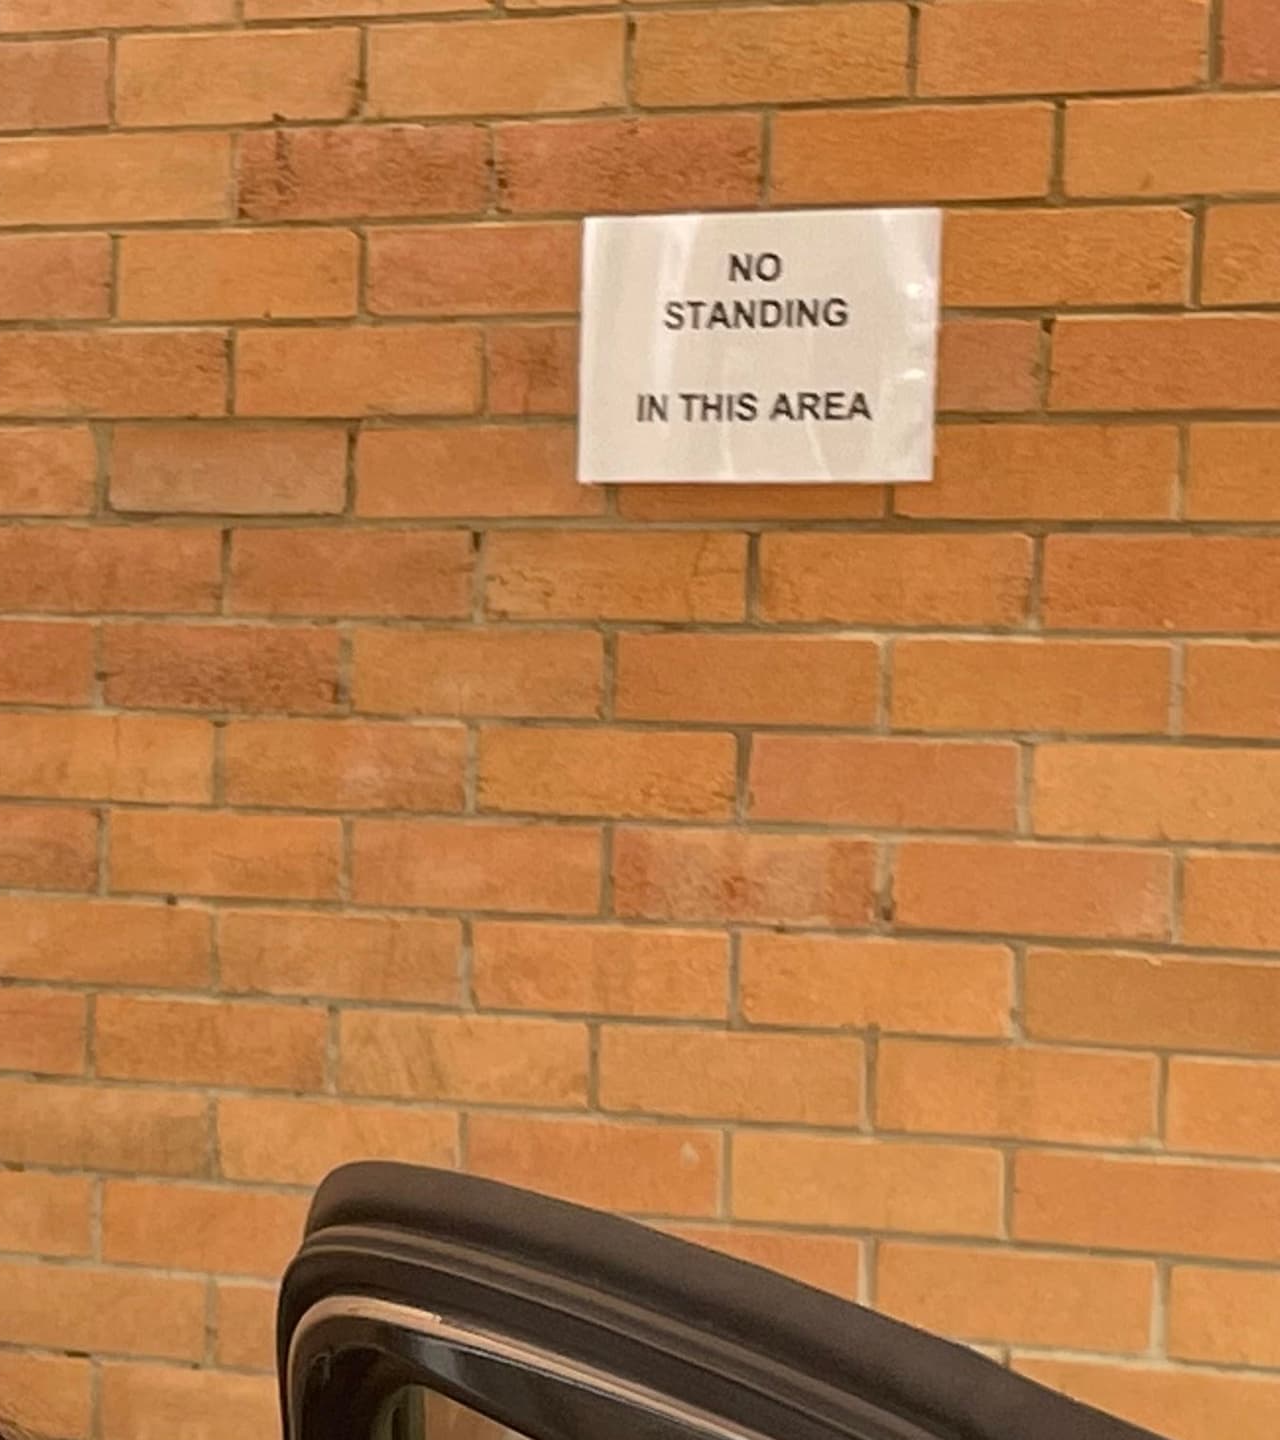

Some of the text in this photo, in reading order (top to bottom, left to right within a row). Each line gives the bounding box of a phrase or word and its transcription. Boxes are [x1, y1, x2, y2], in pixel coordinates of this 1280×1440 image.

[728, 252, 783, 283] NO
[663, 297, 849, 331] STANDING
[636, 392, 873, 423] IN THIS AREA
